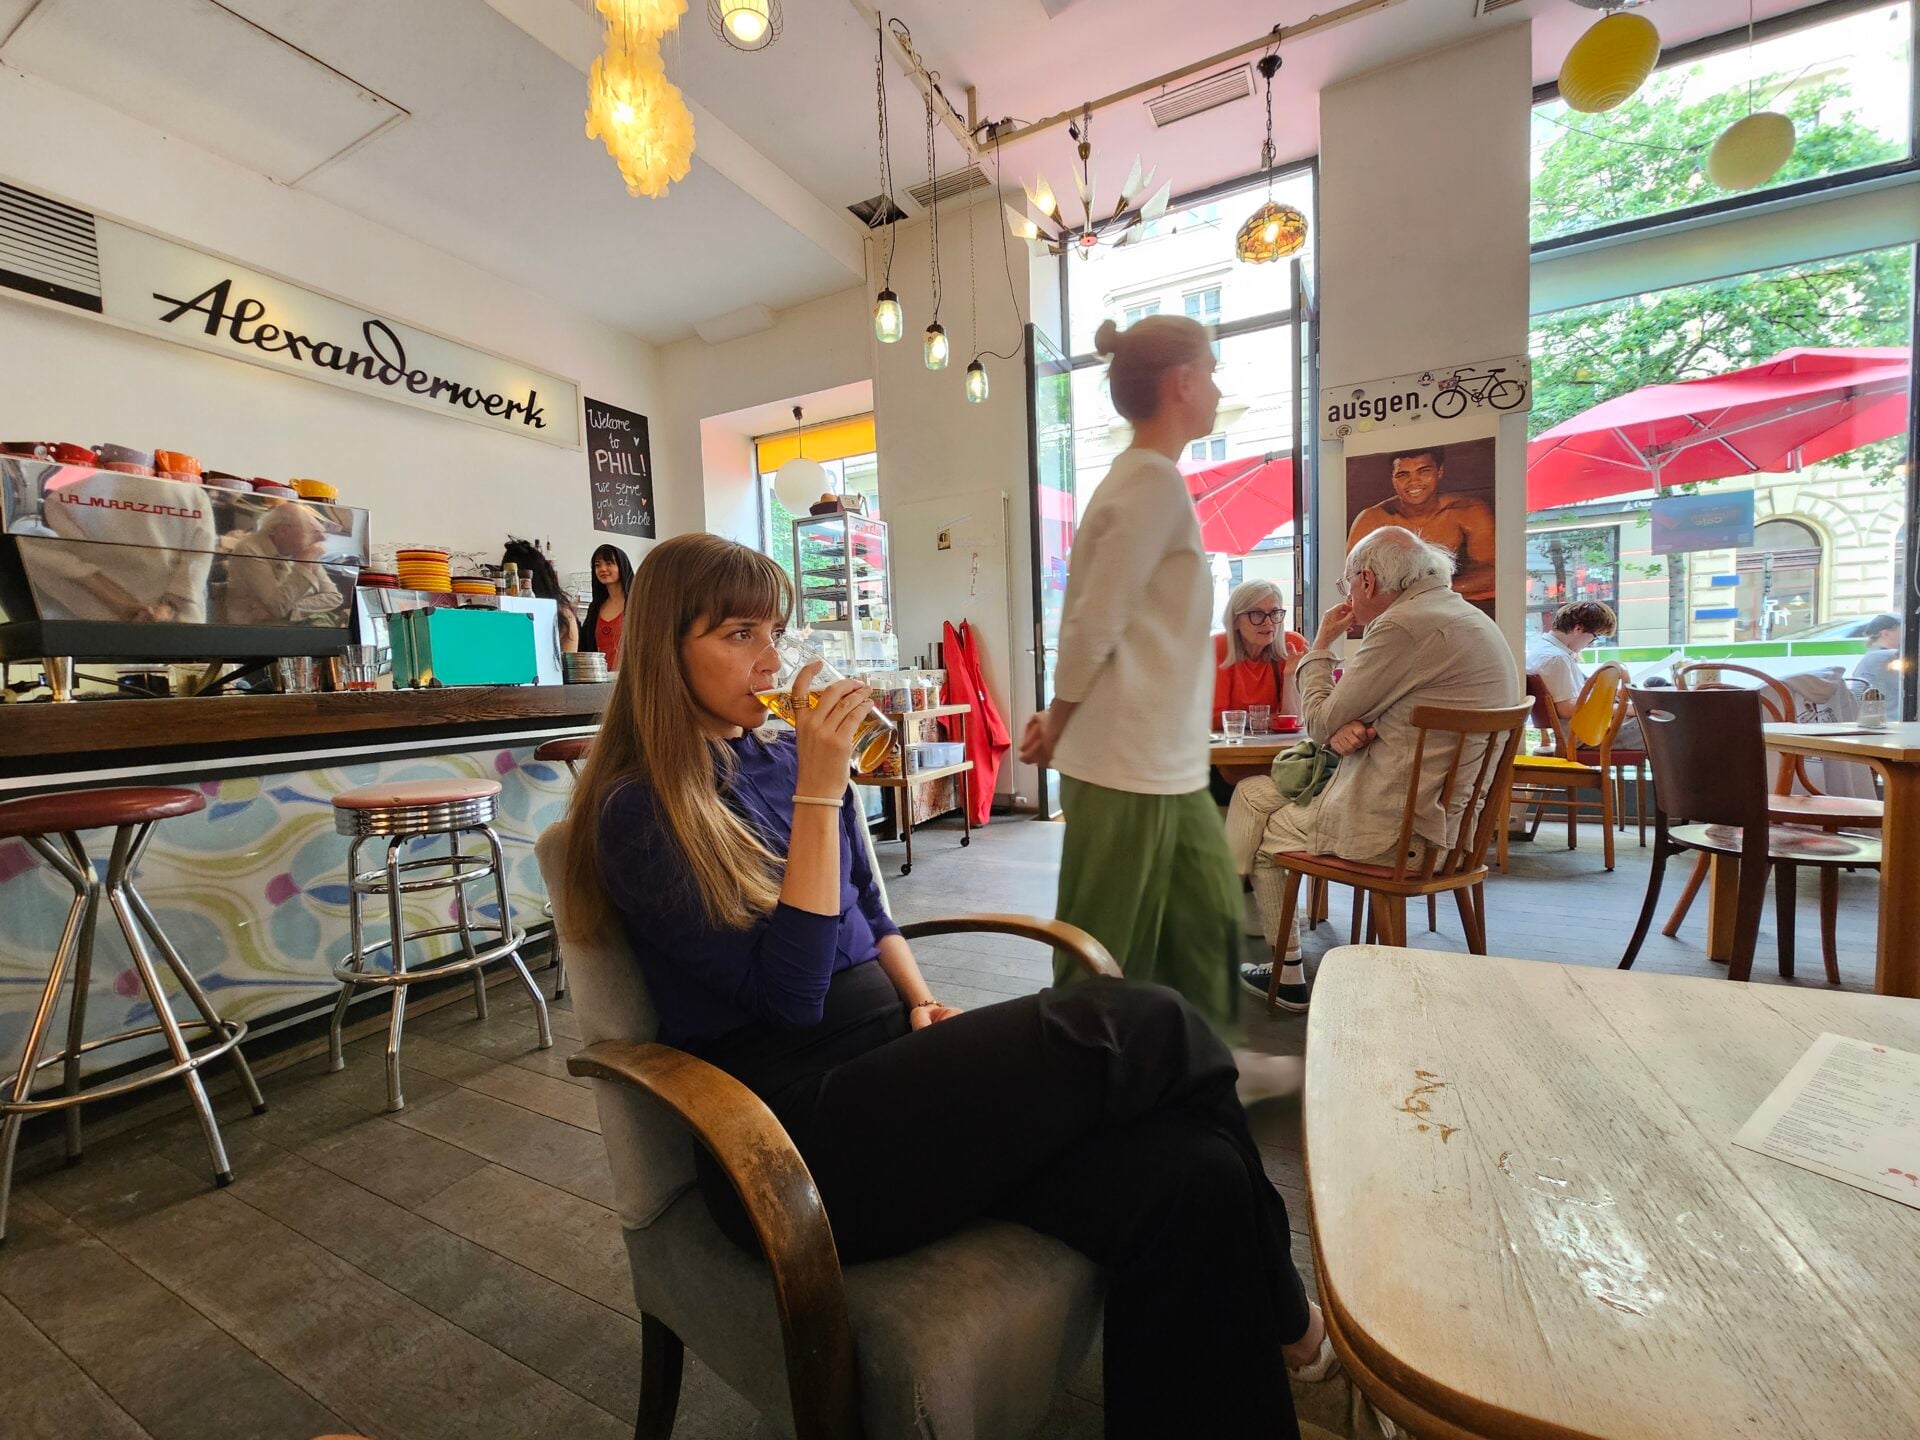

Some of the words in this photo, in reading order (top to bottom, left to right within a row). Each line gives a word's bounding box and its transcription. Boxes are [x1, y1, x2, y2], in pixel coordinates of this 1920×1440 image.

[153, 280, 546, 428] Alexanderwerk
[1328, 391, 1428, 422] ausgen.
[588, 409, 631, 431] Welcome
[609, 433, 620, 448] to
[595, 449, 647, 476] PHIL!
[60, 493, 79, 505] LA
[616, 483, 642, 495] serve
[596, 500, 613, 519] you
[618, 497, 630, 507] at
[609, 512, 624, 526] the
[627, 511, 651, 526] table
